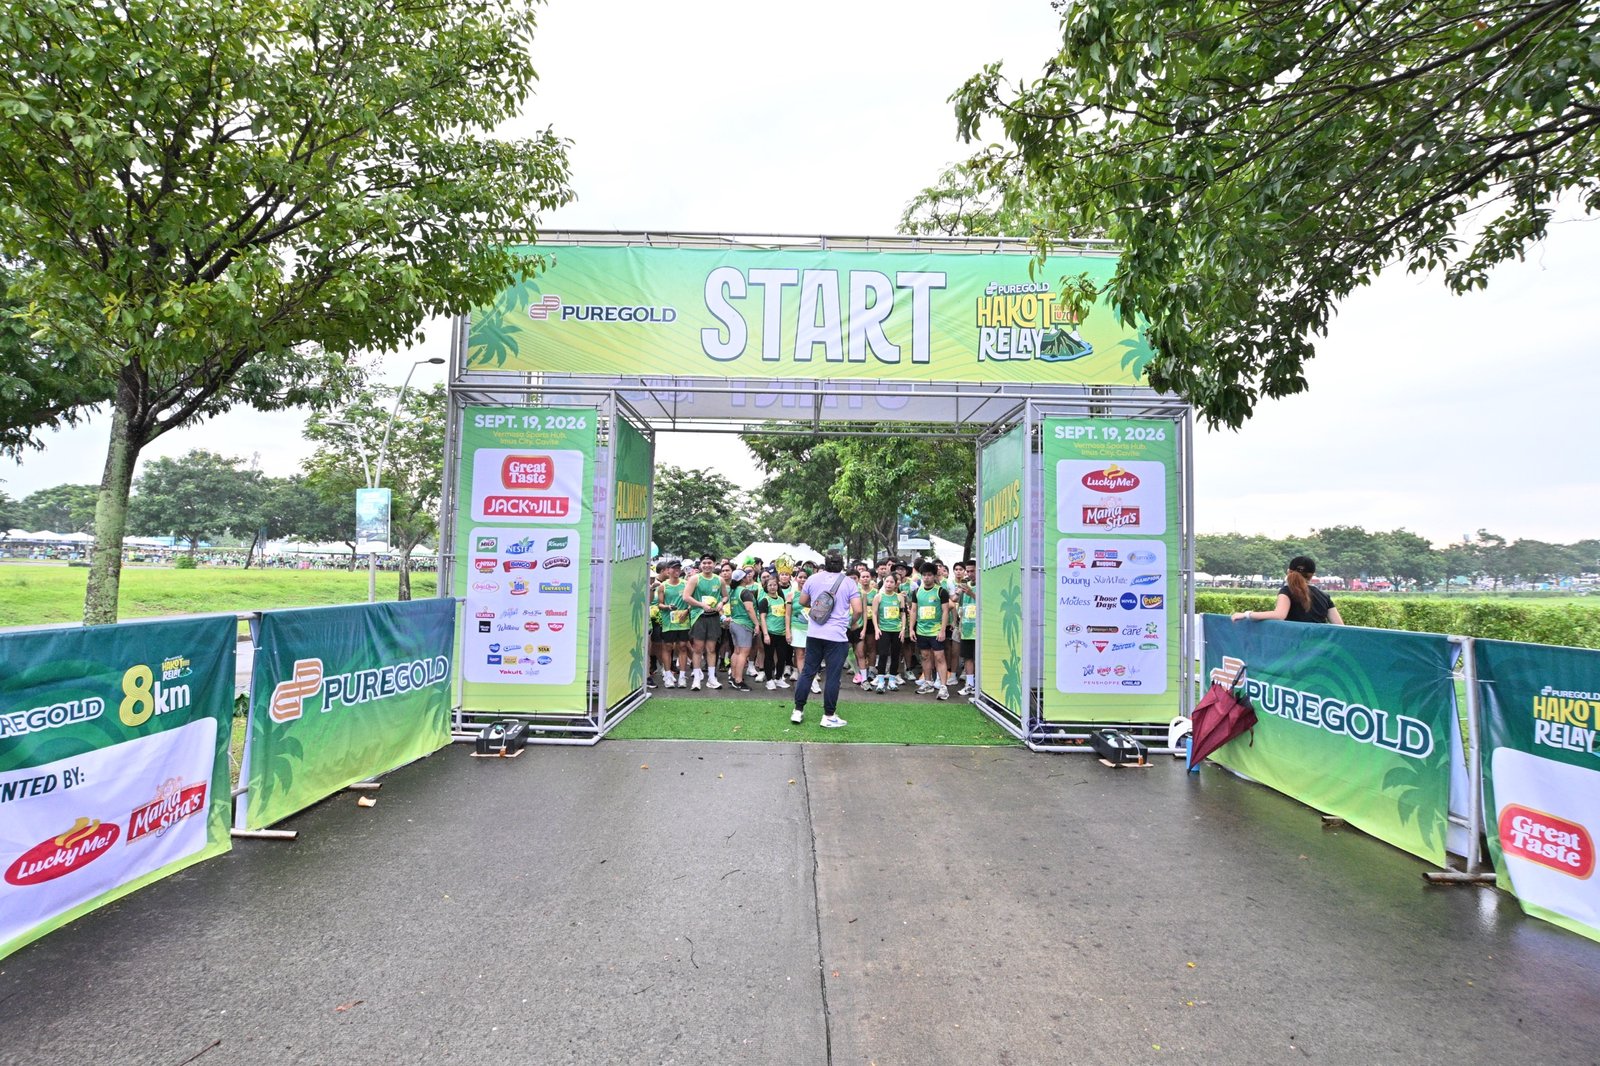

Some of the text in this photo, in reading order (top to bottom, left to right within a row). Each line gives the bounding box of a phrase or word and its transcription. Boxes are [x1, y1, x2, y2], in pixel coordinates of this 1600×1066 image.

[998, 283, 1051, 295] PUREGOLD
[561, 304, 678, 323] PUREGOLD
[701, 266, 947, 364] START
[976, 292, 1057, 328] HAKOT
[978, 327, 1045, 362] RELAY
[475, 415, 587, 431] SEPT. 19, 2026
[1055, 426, 1166, 442] SEPT. 19, 2026
[509, 462, 547, 473] Great
[509, 473, 546, 484] Taste
[1087, 477, 1135, 489] Lucky Me!
[616, 480, 647, 520] ALWAYS
[984, 479, 1020, 536] ALWAYS
[1086, 506, 1122, 525] Mama
[1104, 512, 1137, 531] Sita's
[615, 522, 646, 563] PANALO
[983, 520, 1019, 571] PANALO
[1062, 575, 1091, 587] Downy
[1060, 597, 1091, 606] Modess
[1095, 602, 1117, 610] Days
[496, 624, 519, 632] Wilkins
[1122, 628, 1142, 636] care
[162, 657, 184, 671] HAKOT
[321, 656, 449, 712] PUREGOLD
[1552, 690, 1600, 701] PUREGOLD
[1246, 680, 1433, 758] PUREGOLD
[1534, 718, 1597, 754] RELAY
[0, 766, 85, 803] NTED BY:
[132, 790, 183, 839] Mama
[155, 791, 202, 839] Sita's
[1511, 815, 1582, 851] Great
[16, 830, 114, 880] Lucky Me!
[1510, 829, 1582, 867] Taste
